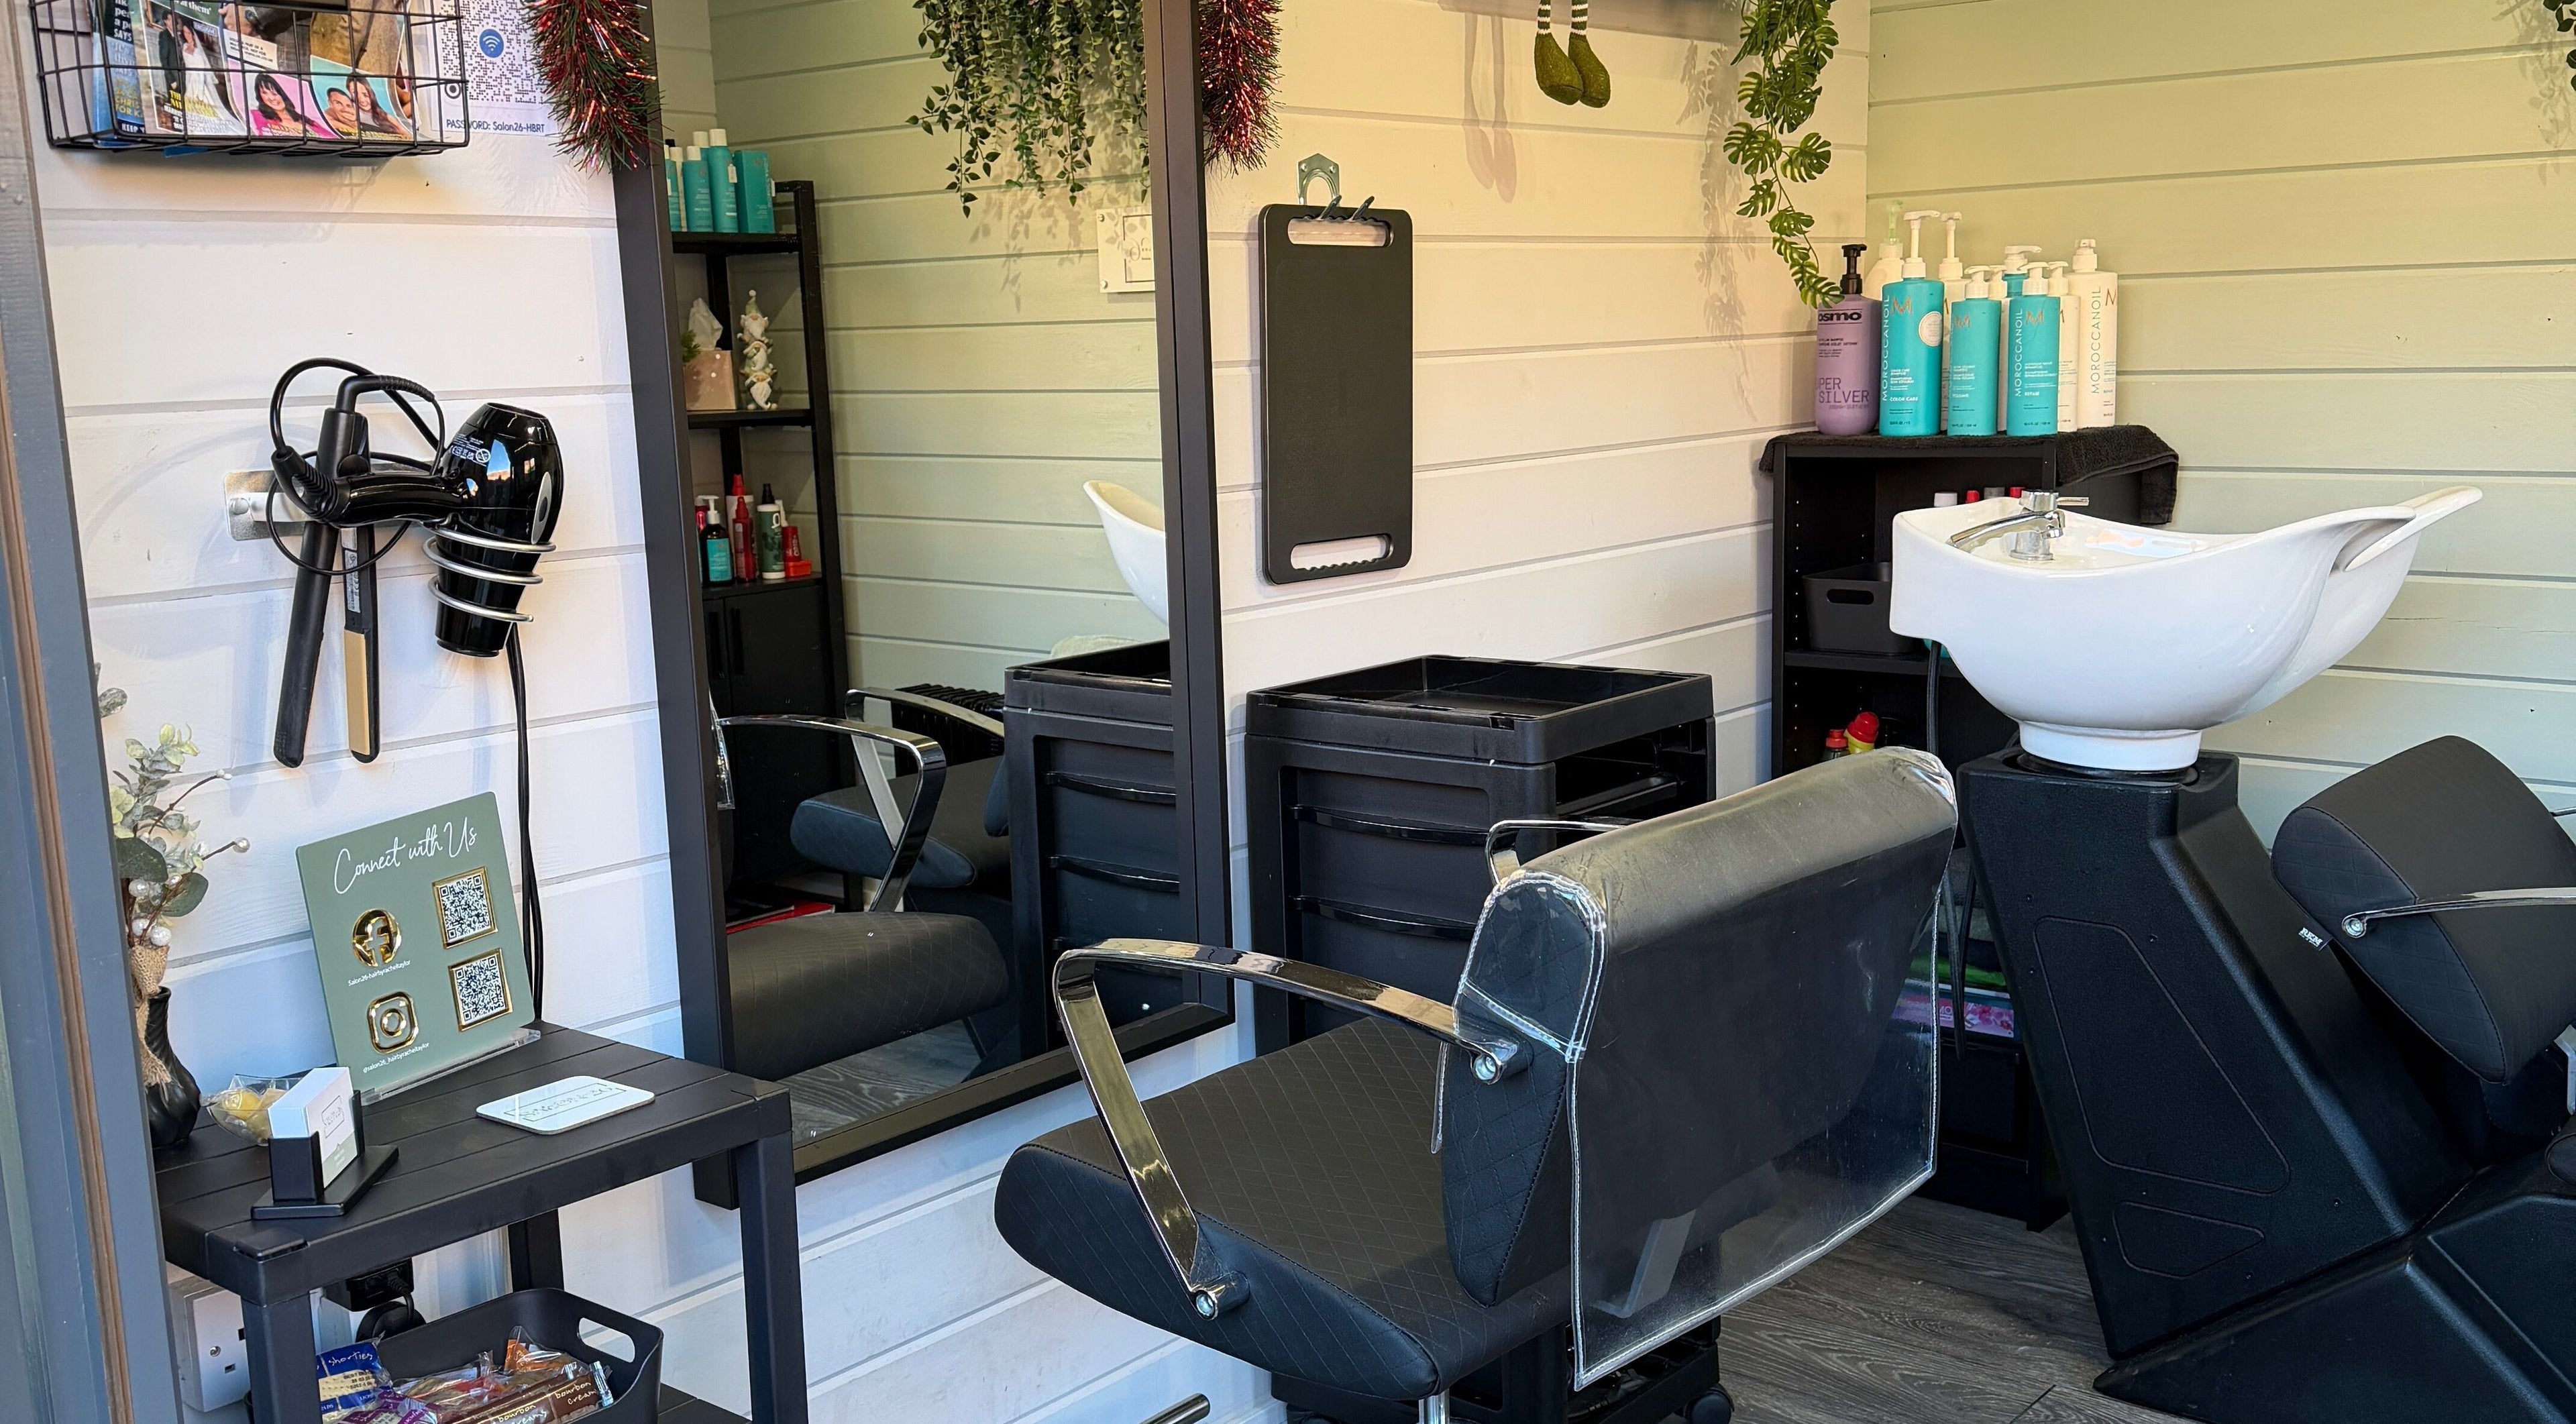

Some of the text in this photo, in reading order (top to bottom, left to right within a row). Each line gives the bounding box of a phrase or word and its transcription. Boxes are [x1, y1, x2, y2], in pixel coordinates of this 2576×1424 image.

[113, 28, 132, 42] SAYS
[121, 123, 138, 133] KEEP
[1818, 311, 1862, 322] osmo
[2090, 286, 2101, 394] MOROCCANOIL
[2015, 309, 2023, 397] MOROCCANOIL
[1816, 377, 1841, 390] PER
[1819, 390, 1870, 403] SILVER
[334, 816, 478, 894] Connect with Us
[328, 1351, 374, 1367] shorties
[555, 1381, 592, 1400] bourbon
[567, 1389, 598, 1405] cream
[498, 1404, 537, 1423] bourbon
